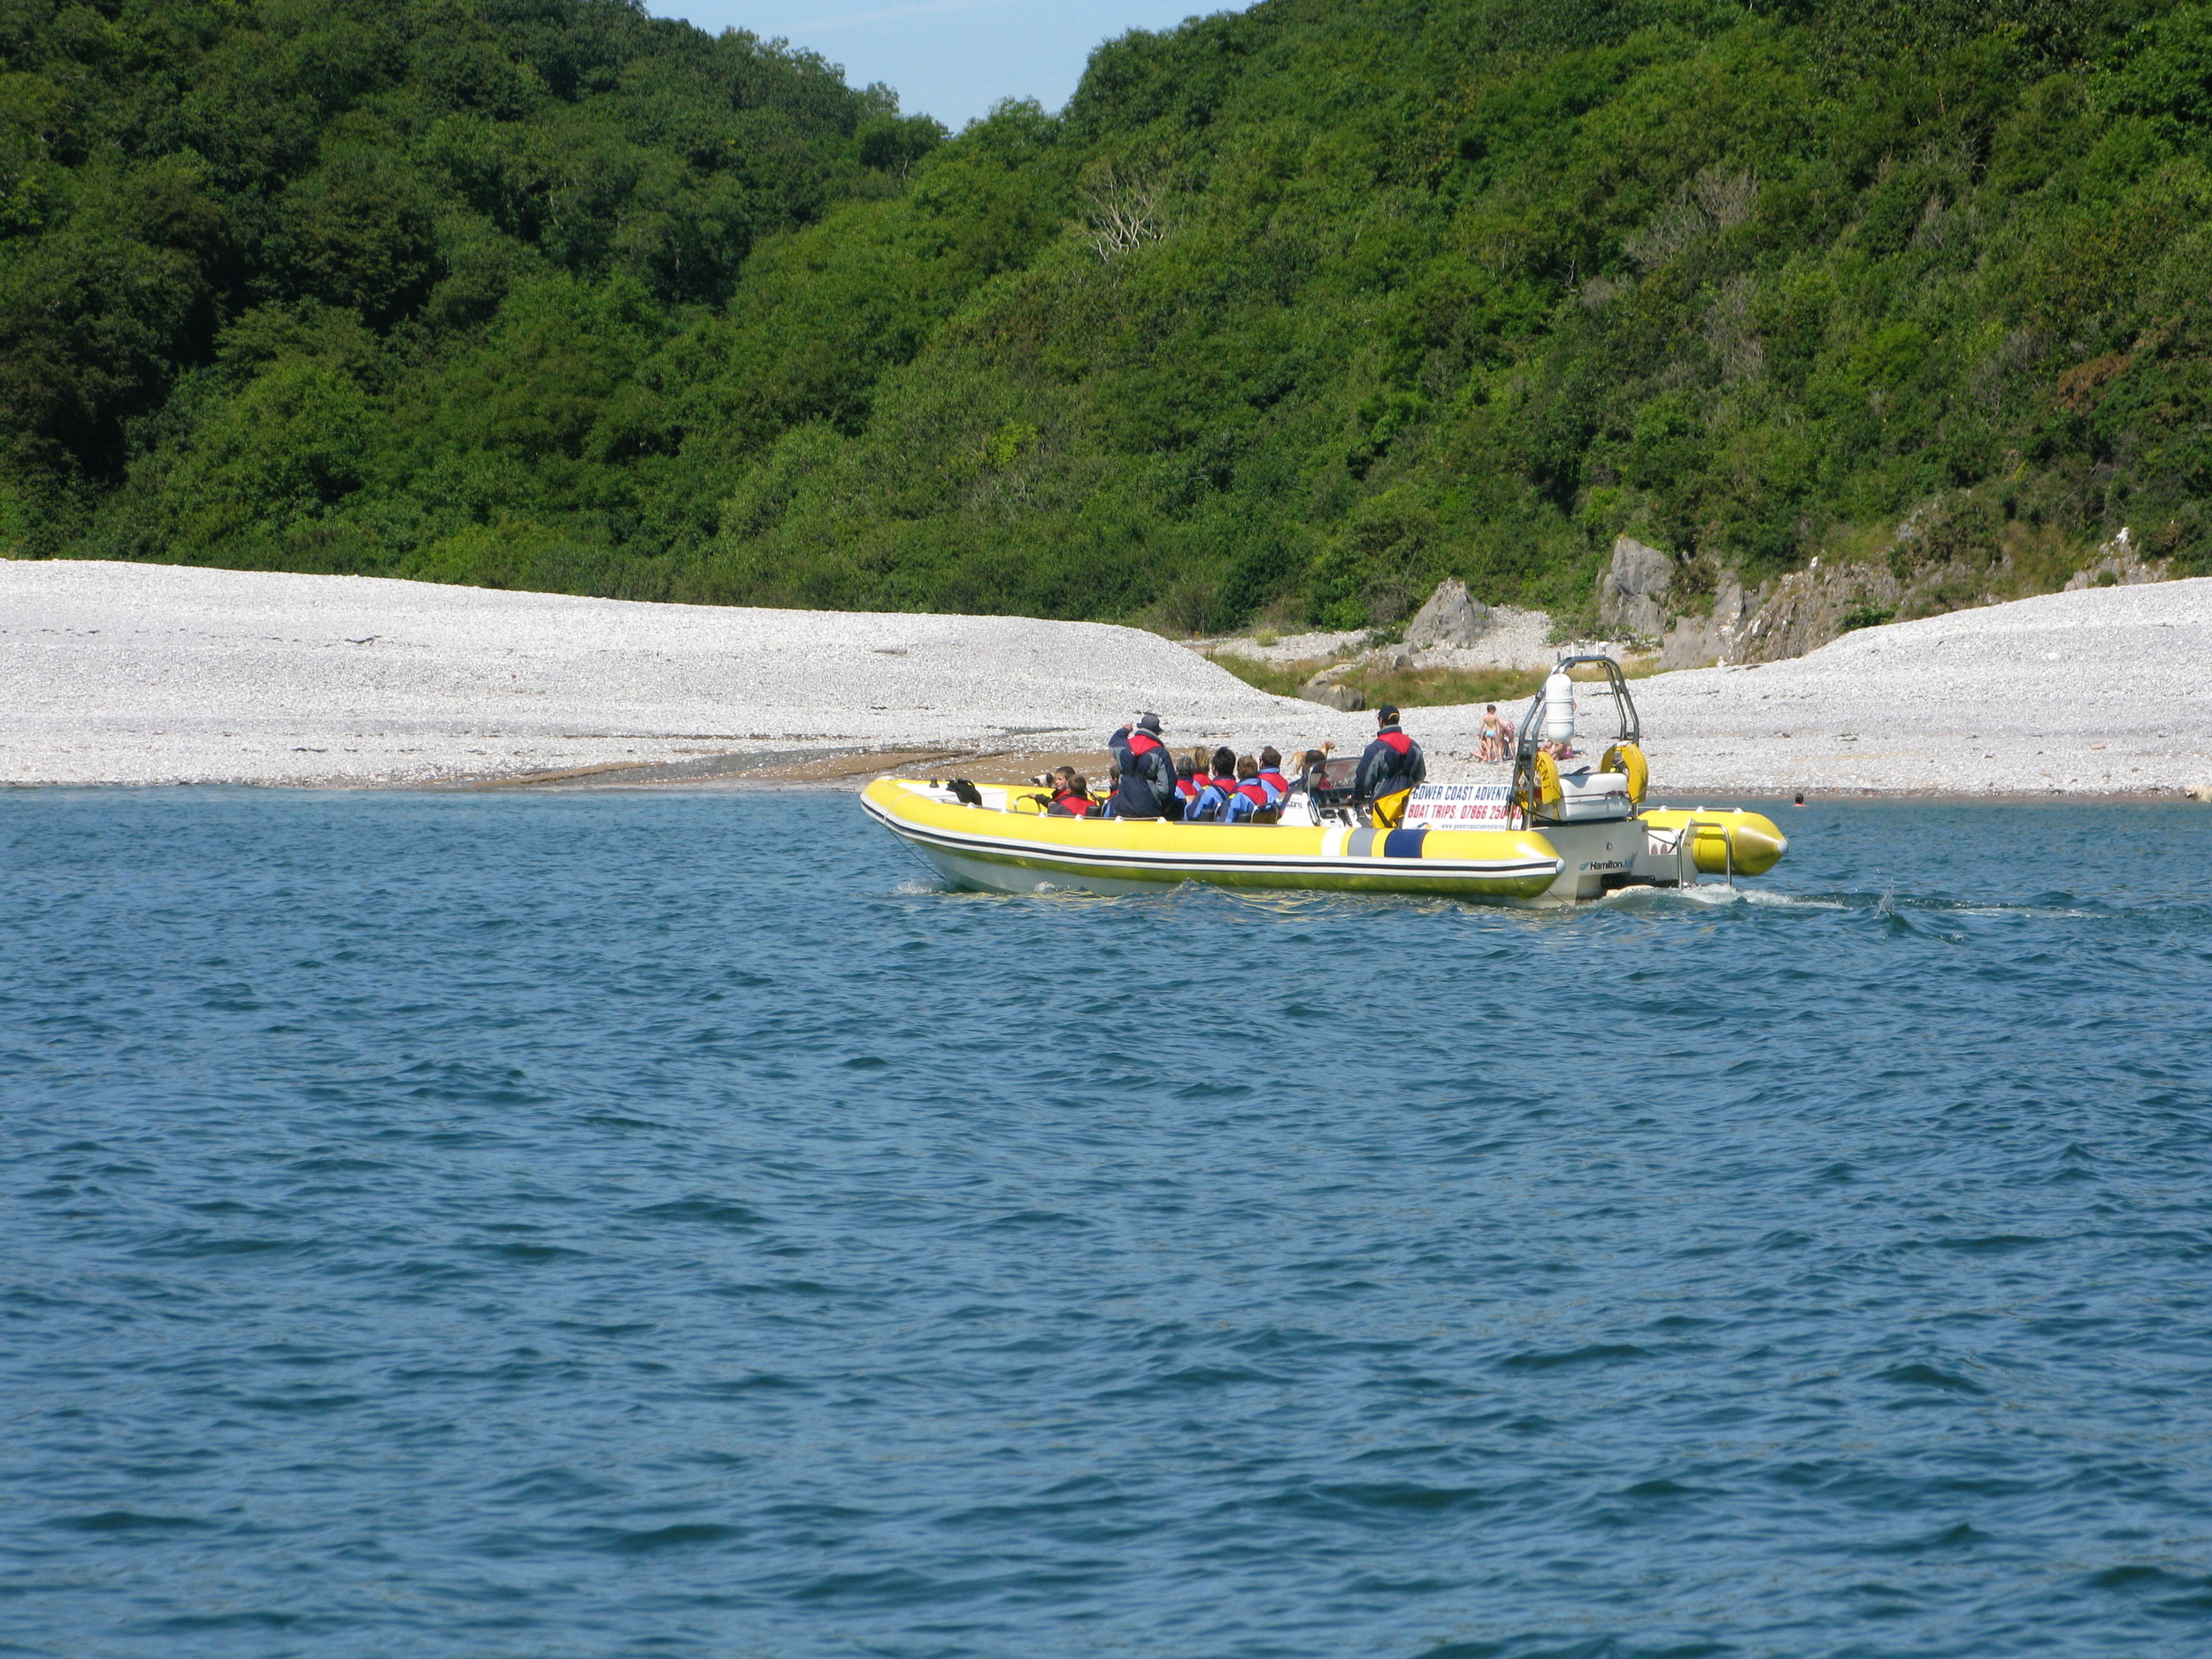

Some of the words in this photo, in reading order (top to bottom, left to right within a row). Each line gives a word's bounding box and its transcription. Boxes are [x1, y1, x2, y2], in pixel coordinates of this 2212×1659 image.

[1412, 785, 1443, 800] GOWER
[1444, 786, 1474, 801] COAST
[1475, 786, 1513, 801] ADVENTU
[1408, 804, 1431, 818] BOAT
[1431, 804, 1458, 819] TRIPS:
[1460, 805, 1488, 819] 07866
